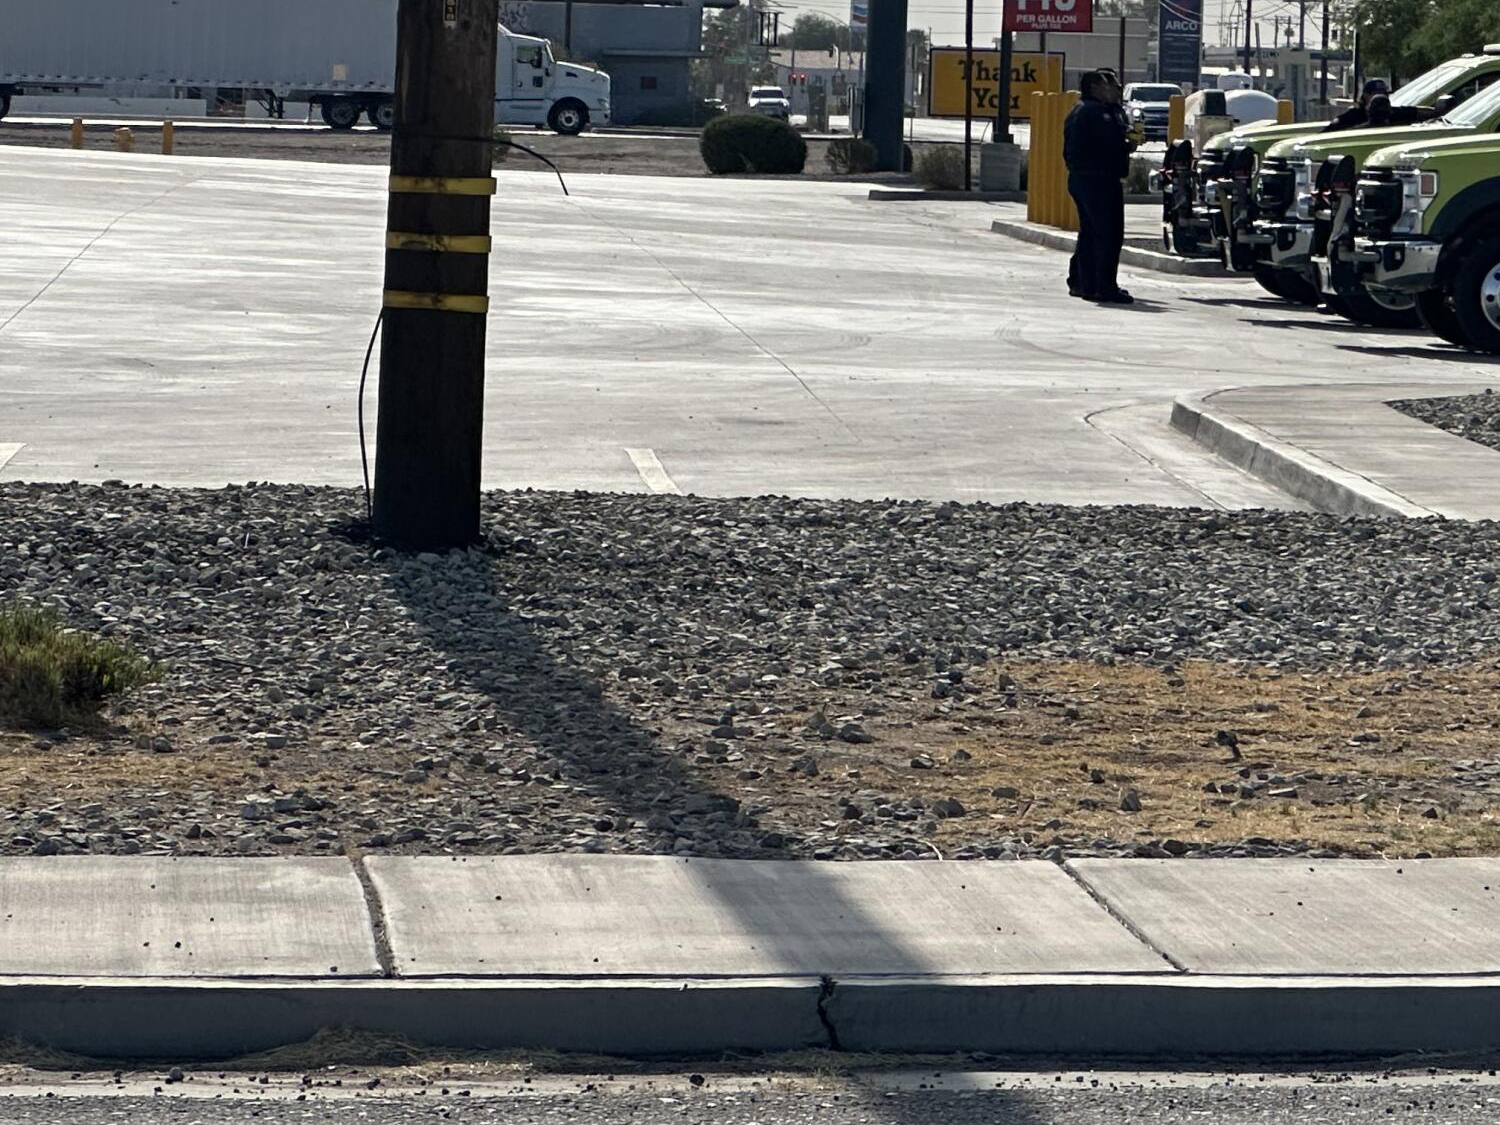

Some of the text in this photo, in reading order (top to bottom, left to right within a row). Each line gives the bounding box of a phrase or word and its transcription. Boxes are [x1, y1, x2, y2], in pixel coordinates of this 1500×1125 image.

[1016, 14, 1077, 24] PER GALLON
[1165, 20, 1198, 31] ARCO
